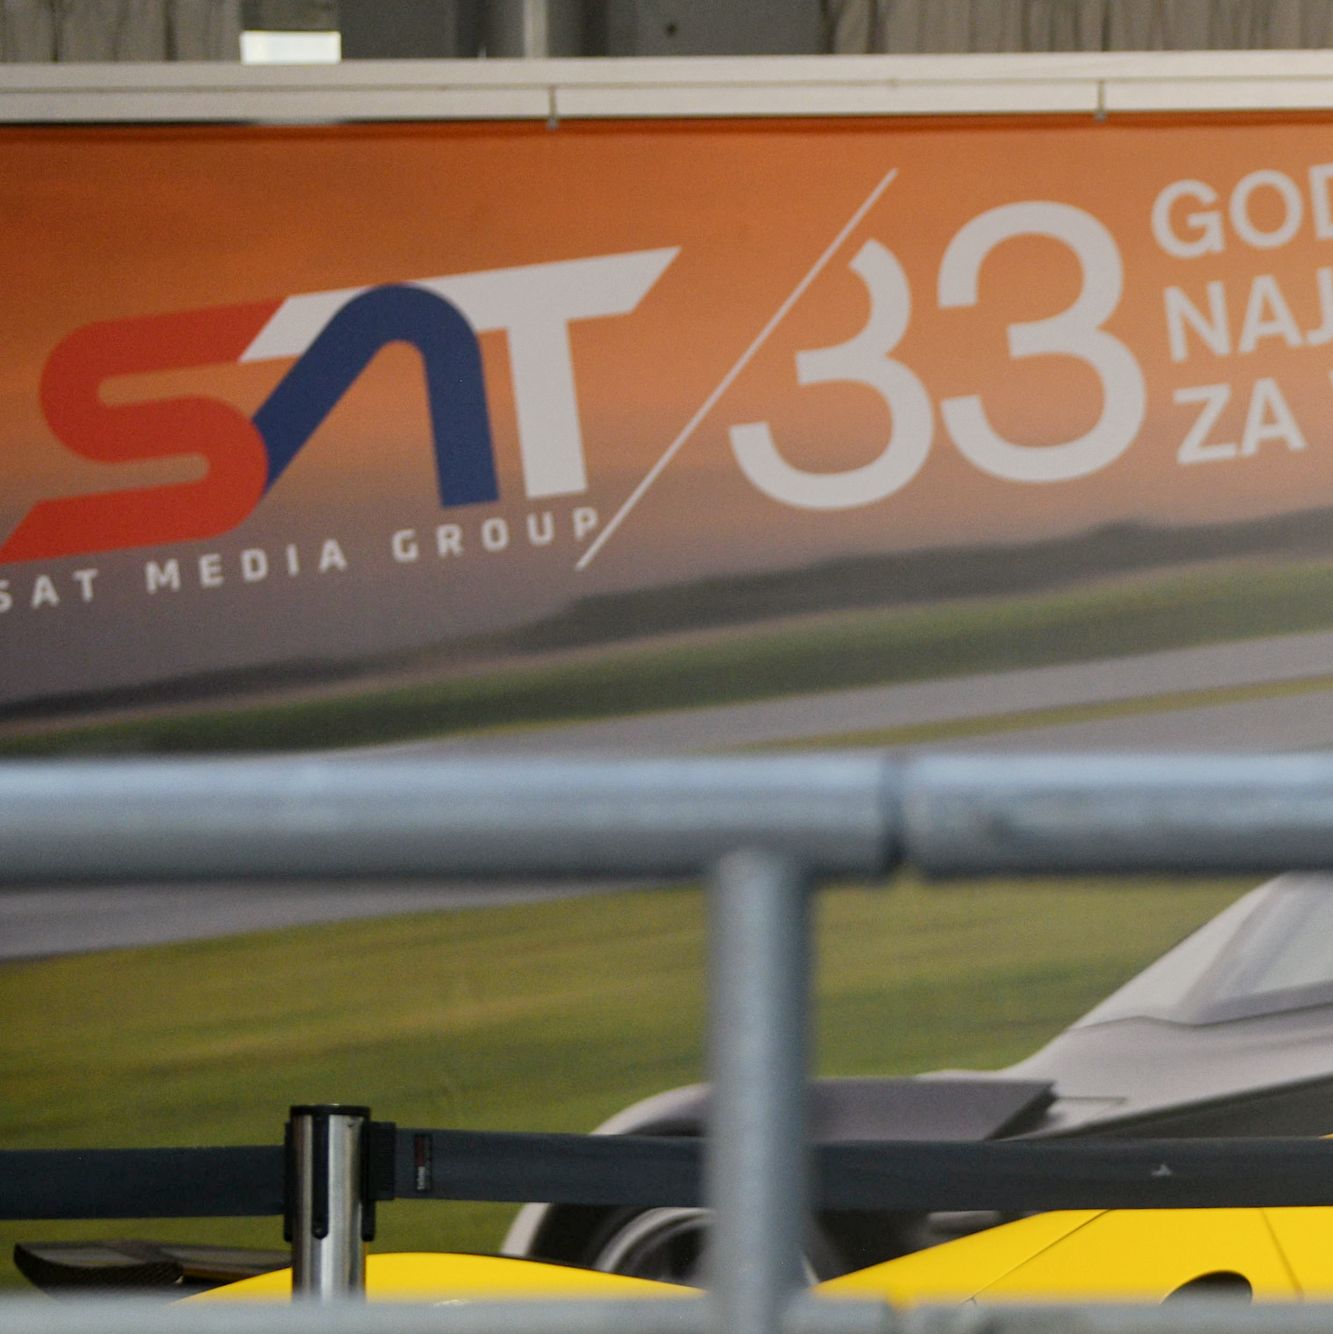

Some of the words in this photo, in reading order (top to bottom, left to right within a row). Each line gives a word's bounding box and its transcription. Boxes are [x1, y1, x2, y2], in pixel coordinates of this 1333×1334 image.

[728, 199, 1147, 511] 33
[1174, 377, 1307, 466] ZA
[0, 567, 99, 614] SAT
[145, 537, 348, 595] MEDIA
[391, 506, 599, 564] GROUP
